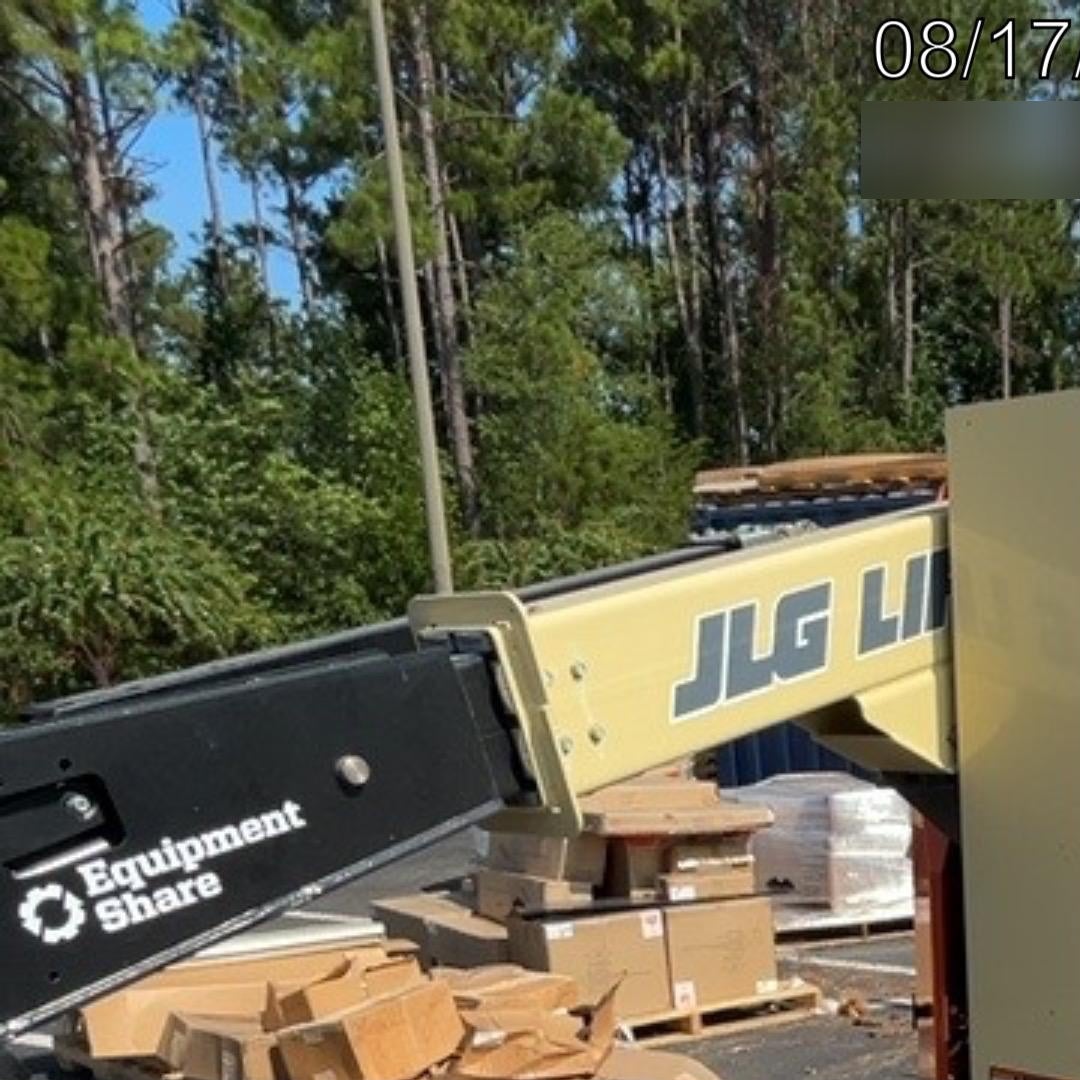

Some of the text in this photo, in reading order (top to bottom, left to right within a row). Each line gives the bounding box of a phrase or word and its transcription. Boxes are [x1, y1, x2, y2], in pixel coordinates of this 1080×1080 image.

[672, 578, 834, 720] JLG
[77, 800, 306, 897] Equipment
[95, 872, 223, 933] Share
